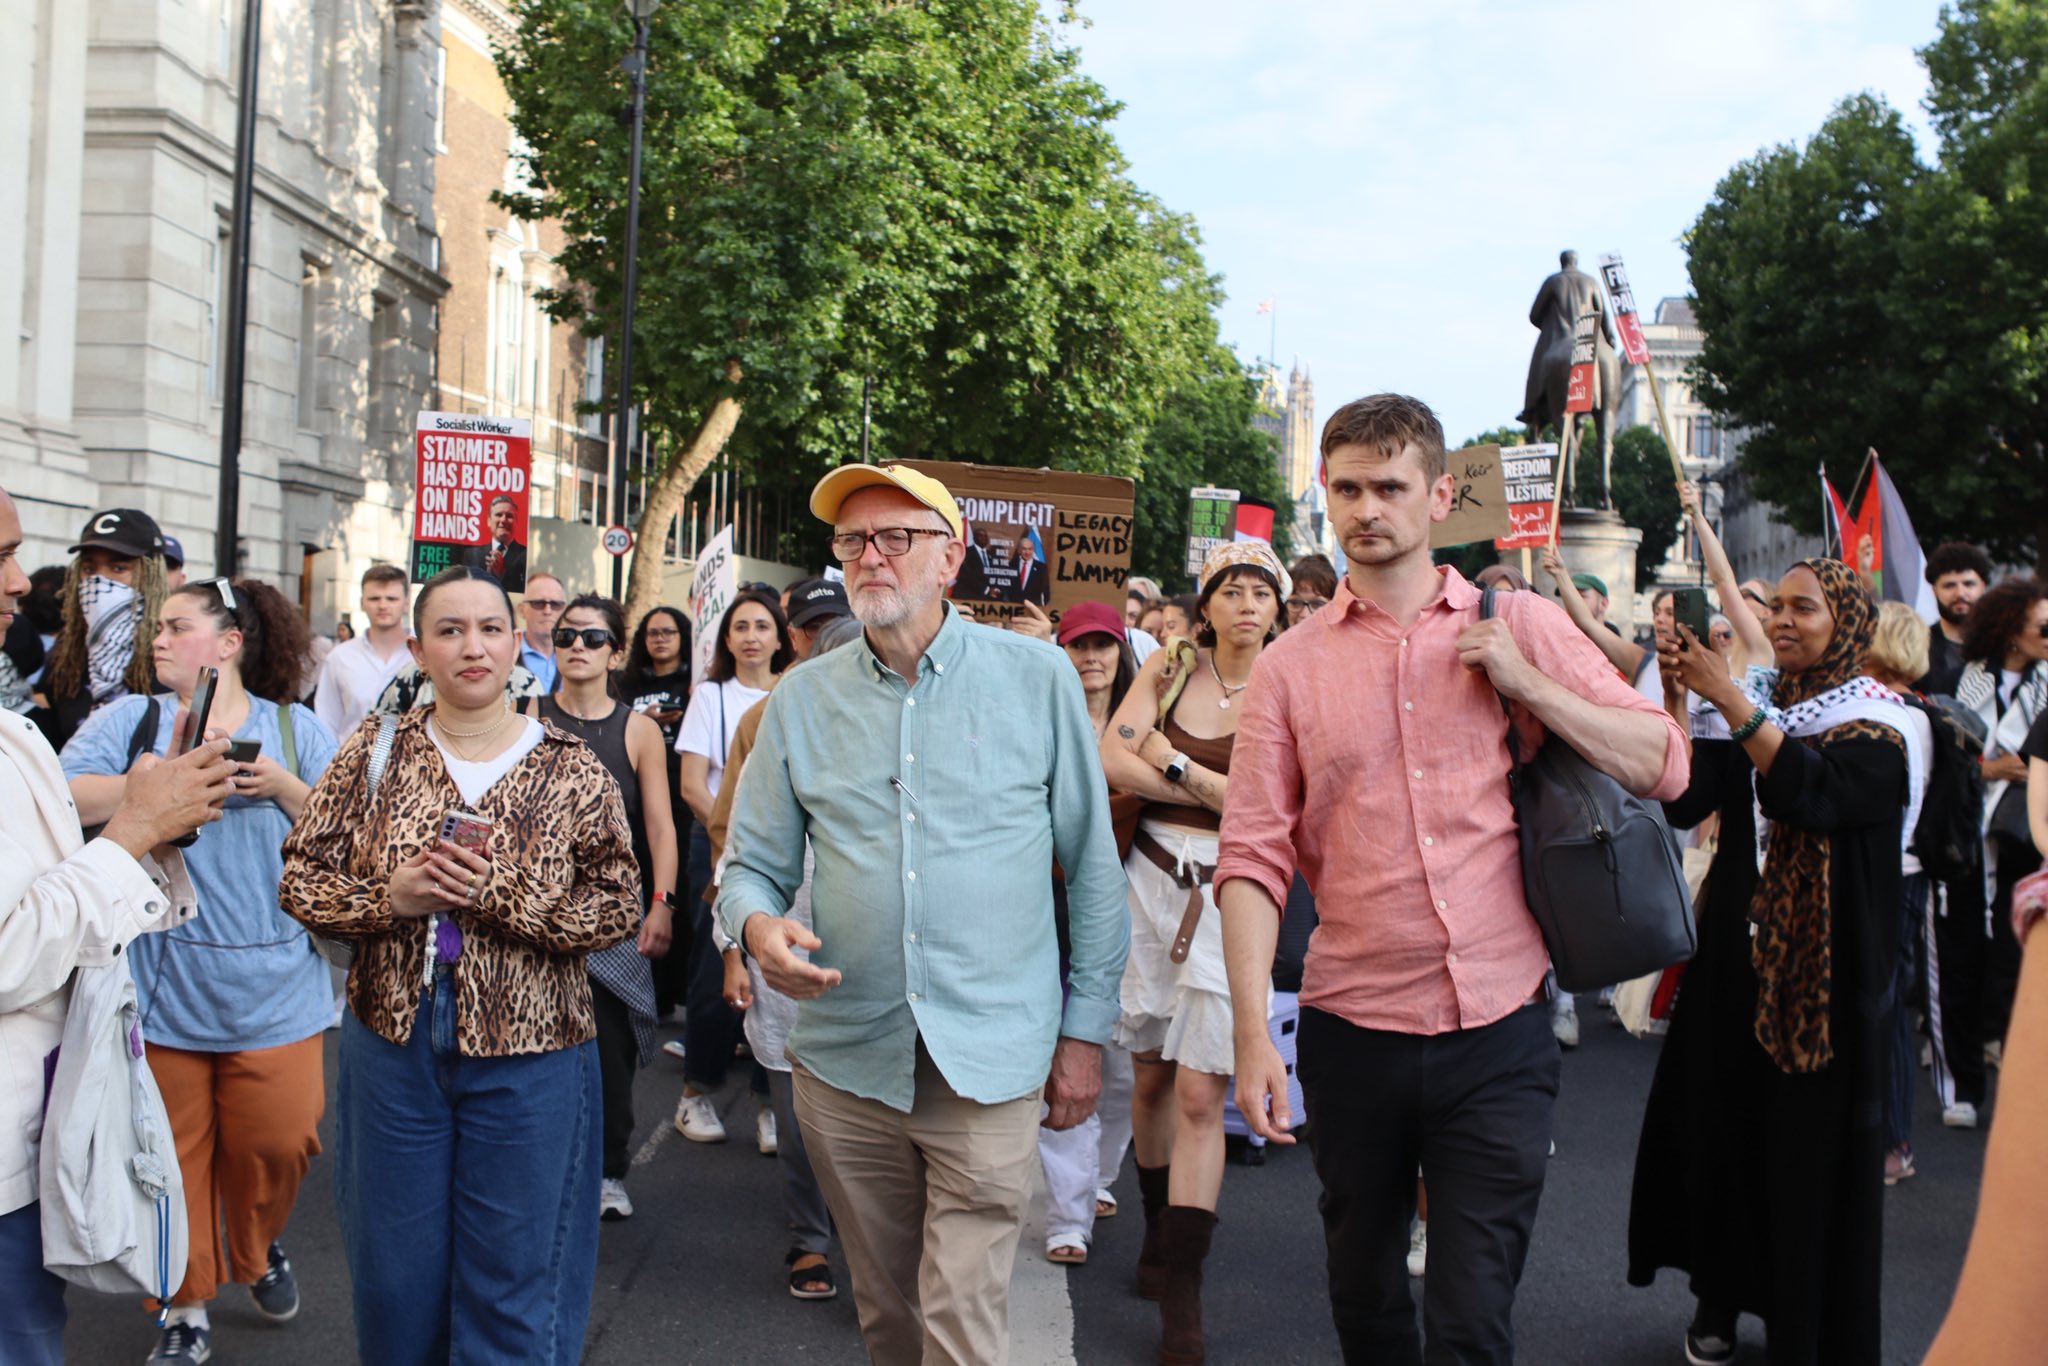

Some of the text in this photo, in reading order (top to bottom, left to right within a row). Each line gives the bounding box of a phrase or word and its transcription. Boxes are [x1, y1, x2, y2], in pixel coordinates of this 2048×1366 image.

[436, 418, 513, 434] Socialist Worker
[423, 435, 508, 465] STARMER
[423, 461, 526, 492] HAS BLOOD
[422, 487, 483, 516] ON HIS
[955, 496, 1055, 528] COMPLICIT
[94, 513, 121, 535] C
[421, 512, 481, 542] HANDS
[1058, 511, 1133, 540] LEGACY
[419, 545, 451, 563] FREE
[607, 534, 629, 548] 20
[1056, 532, 1128, 555] DAVID
[1056, 555, 1131, 589] LAMMY
[806, 587, 835, 600] datto
